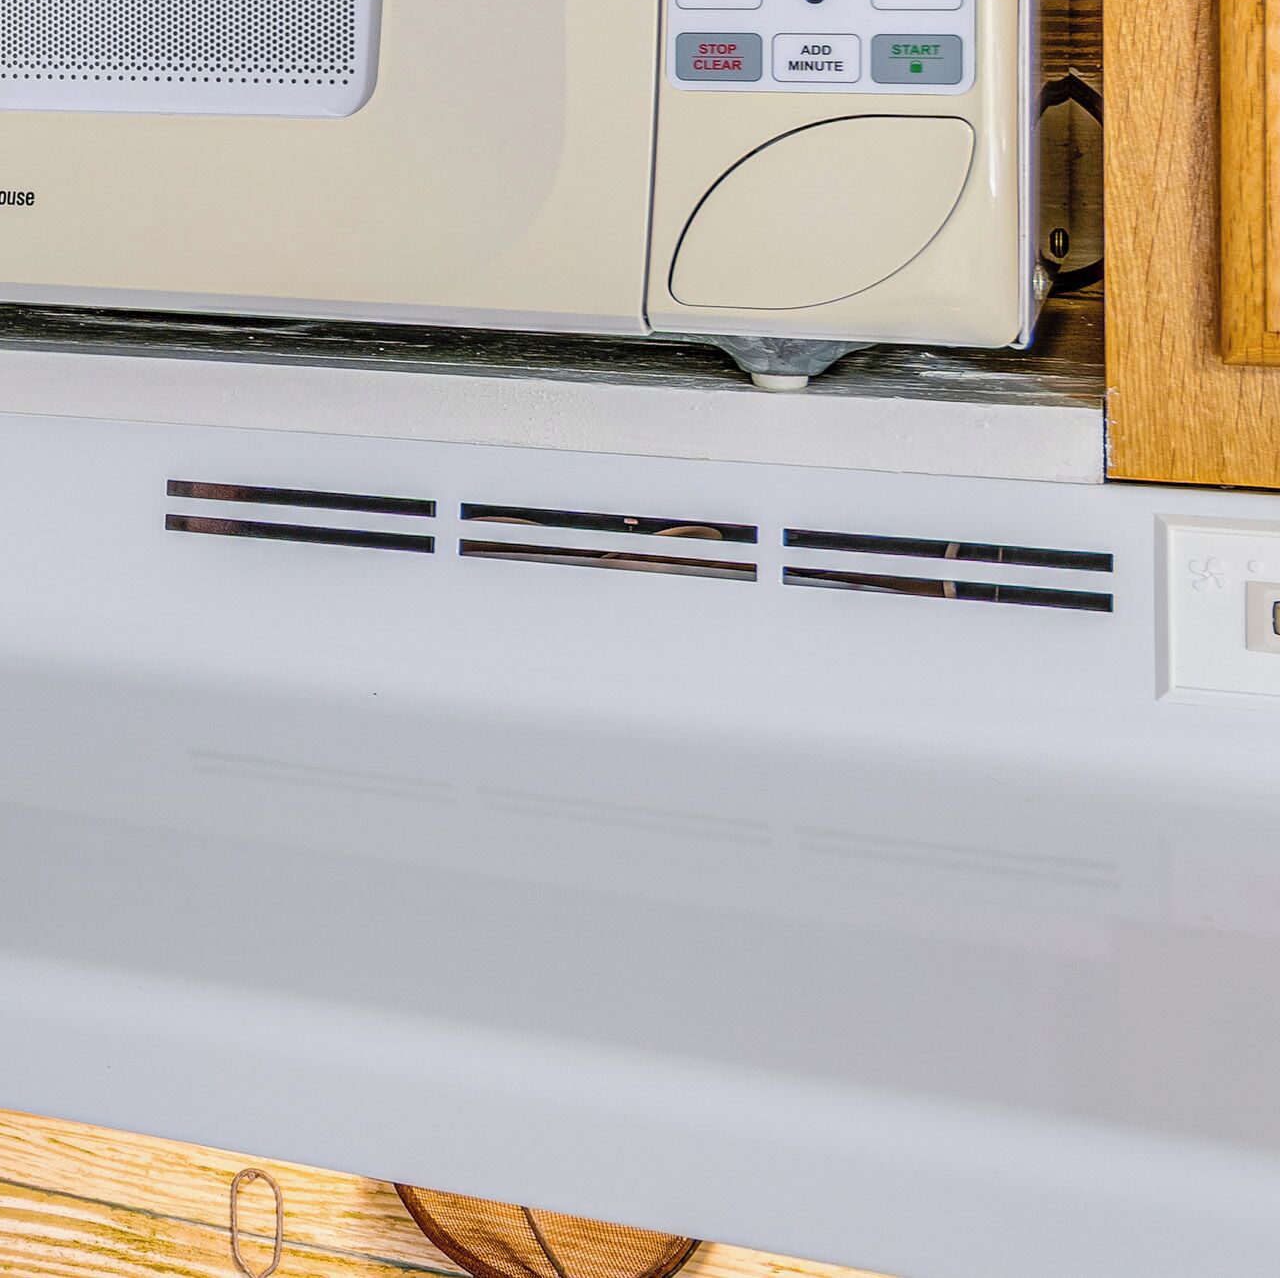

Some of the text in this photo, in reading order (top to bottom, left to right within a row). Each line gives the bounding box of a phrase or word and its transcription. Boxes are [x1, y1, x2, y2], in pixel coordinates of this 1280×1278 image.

[698, 43, 737, 55] STOP
[800, 45, 832, 56] ADD
[891, 43, 941, 56] START
[693, 59, 743, 71] CLEAR
[788, 60, 844, 72] MINUTE
